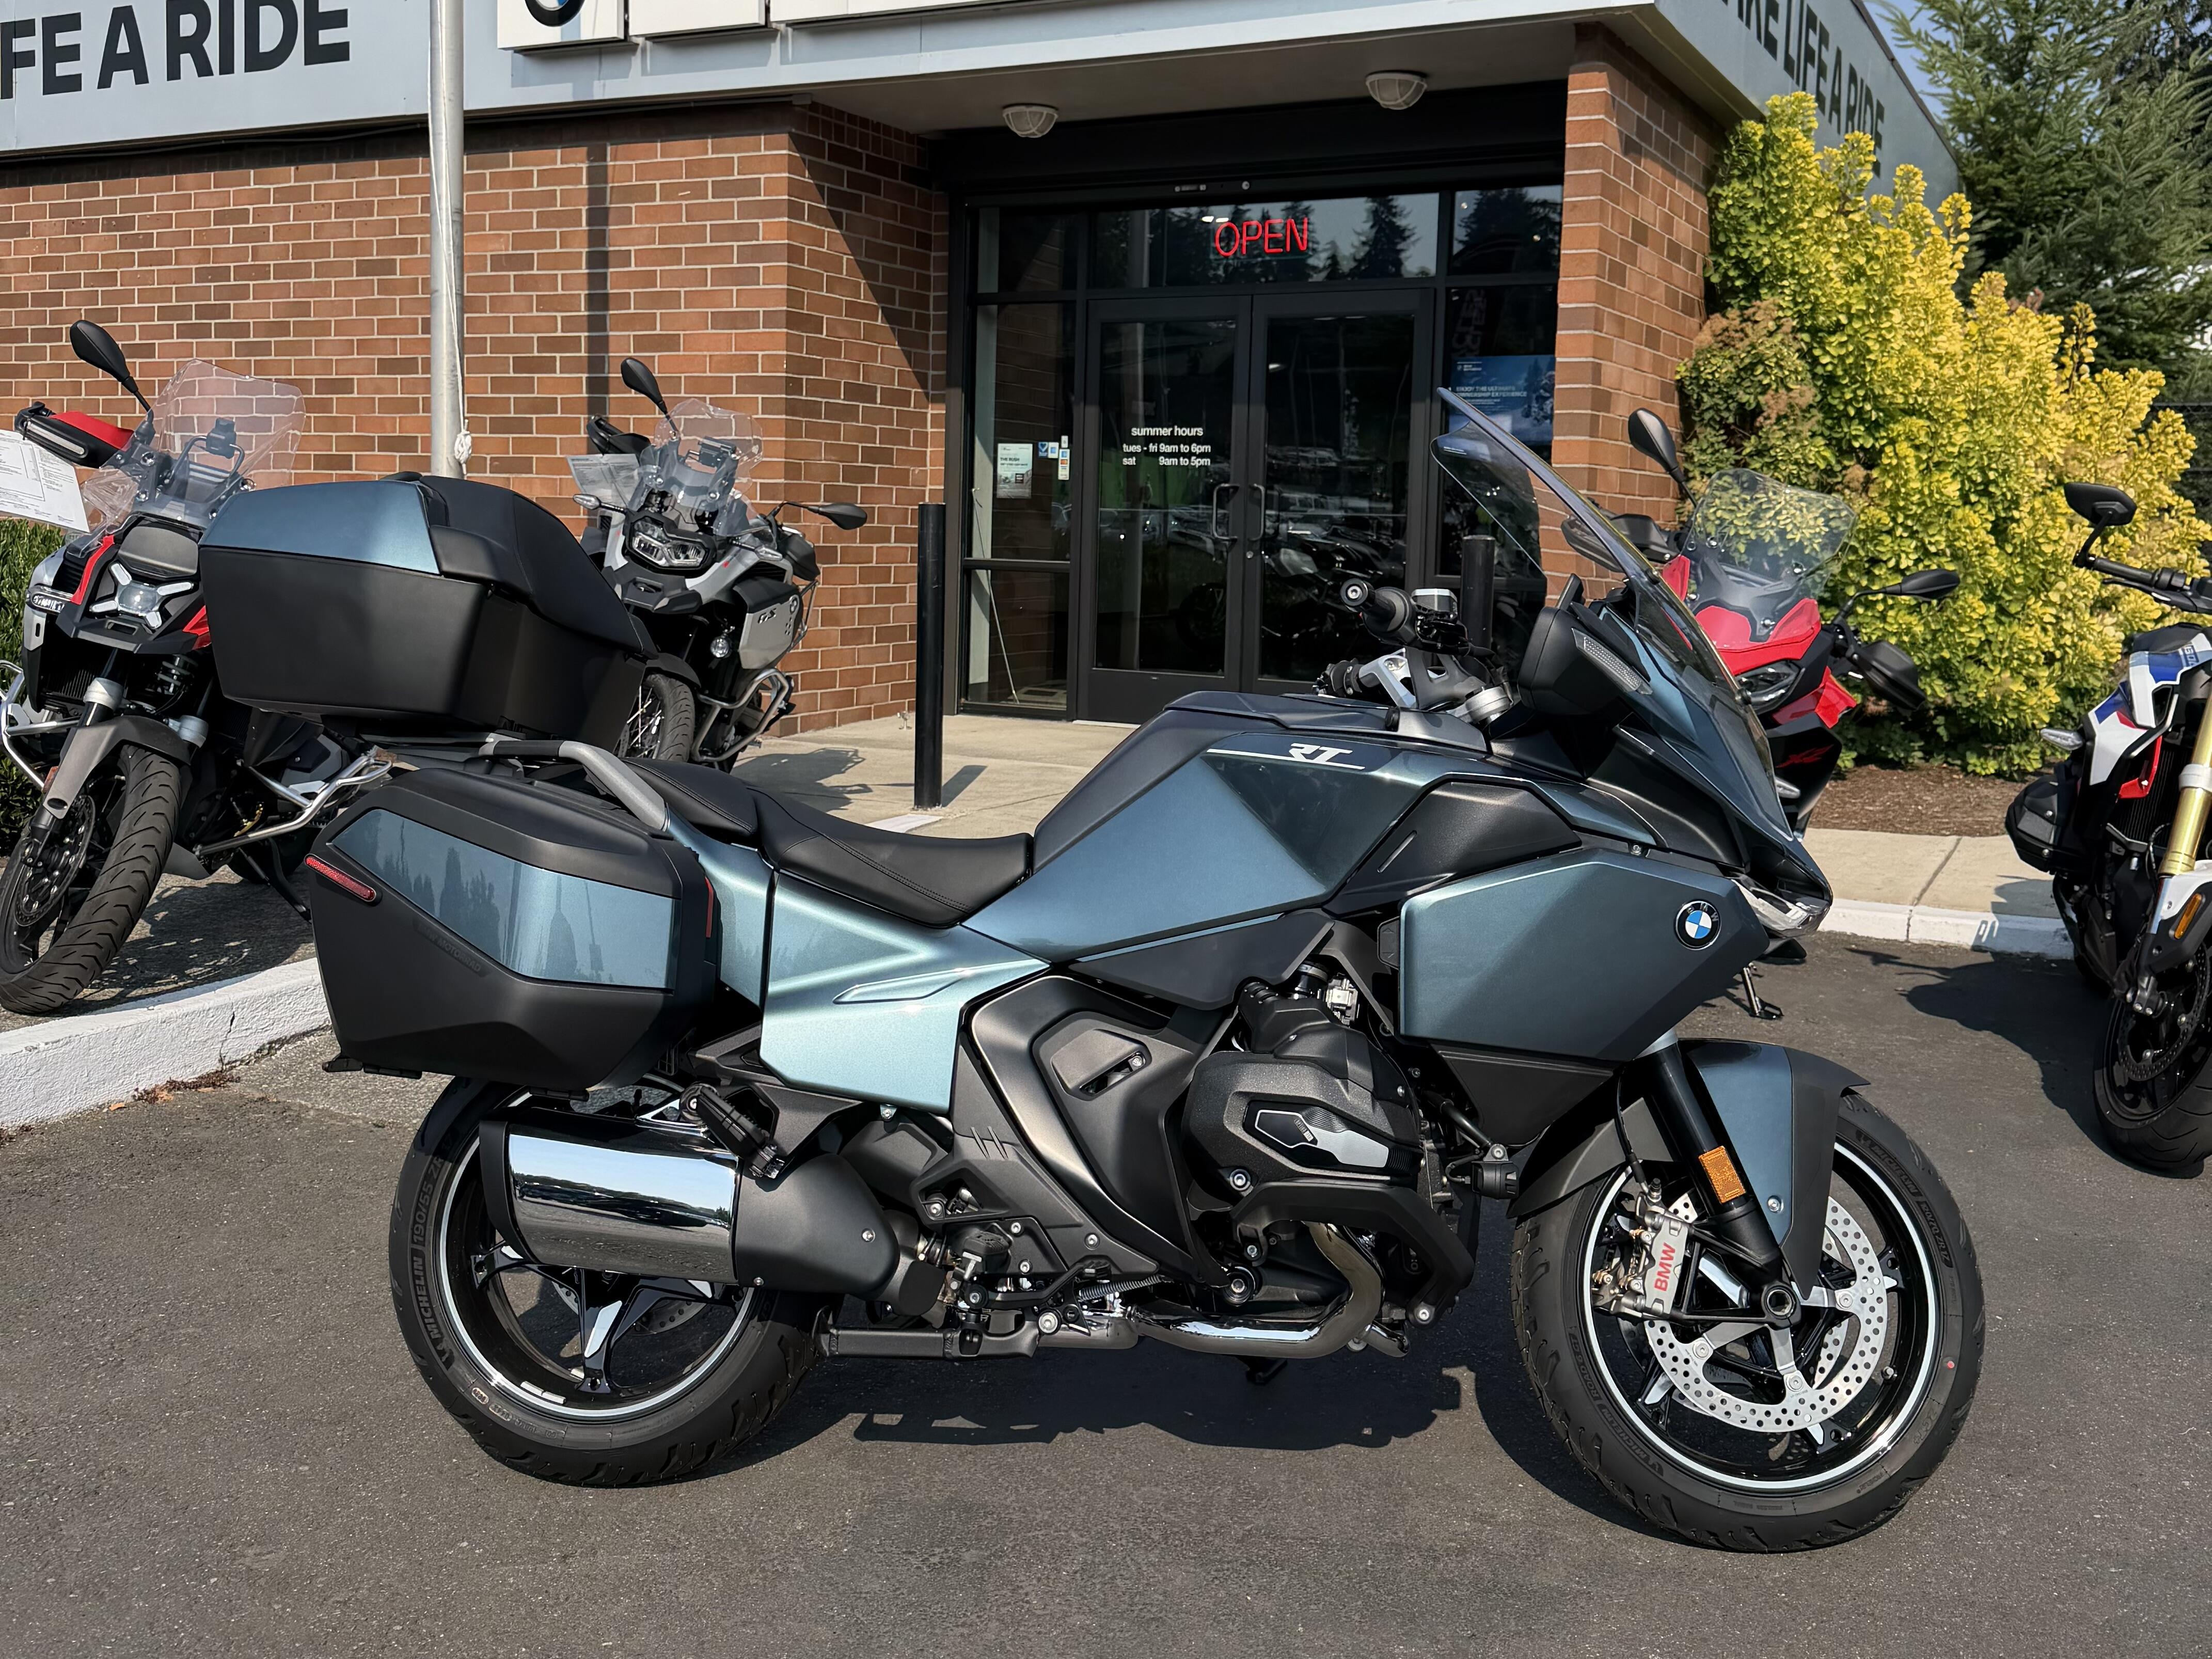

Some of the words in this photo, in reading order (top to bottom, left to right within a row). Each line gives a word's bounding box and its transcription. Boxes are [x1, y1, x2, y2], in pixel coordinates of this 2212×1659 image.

[97, 5, 149, 89] A
[166, 0, 350, 81] RIDE
[1784, 0, 1829, 116] LIFE
[1828, 45, 1842, 135] A
[1844, 62, 1885, 178] RIDE
[1214, 216, 1308, 257] OPEN
[1123, 443, 1142, 452] tues
[1149, 443, 1158, 452] fri
[1159, 443, 1178, 452] 9am
[1180, 443, 1189, 452] to
[1191, 443, 1211, 454] 6pm
[1131, 427, 1173, 436] summer
[1174, 425, 1204, 436] hours
[1123, 456, 1136, 465] sat
[1159, 456, 1178, 465] 9am
[1179, 456, 1189, 465] to
[1191, 456, 1210, 468] 5pm
[1288, 742, 1353, 764] RT
[1871, 1145, 1919, 1196] MICHELIN
[413, 1181, 434, 1243] 190/55
[1654, 1242, 1676, 1291] BMW
[413, 1256, 441, 1339] MICHELIN
[1579, 1365, 1599, 1397] ROAD
[1602, 1408, 1647, 1459] MICHELIN
